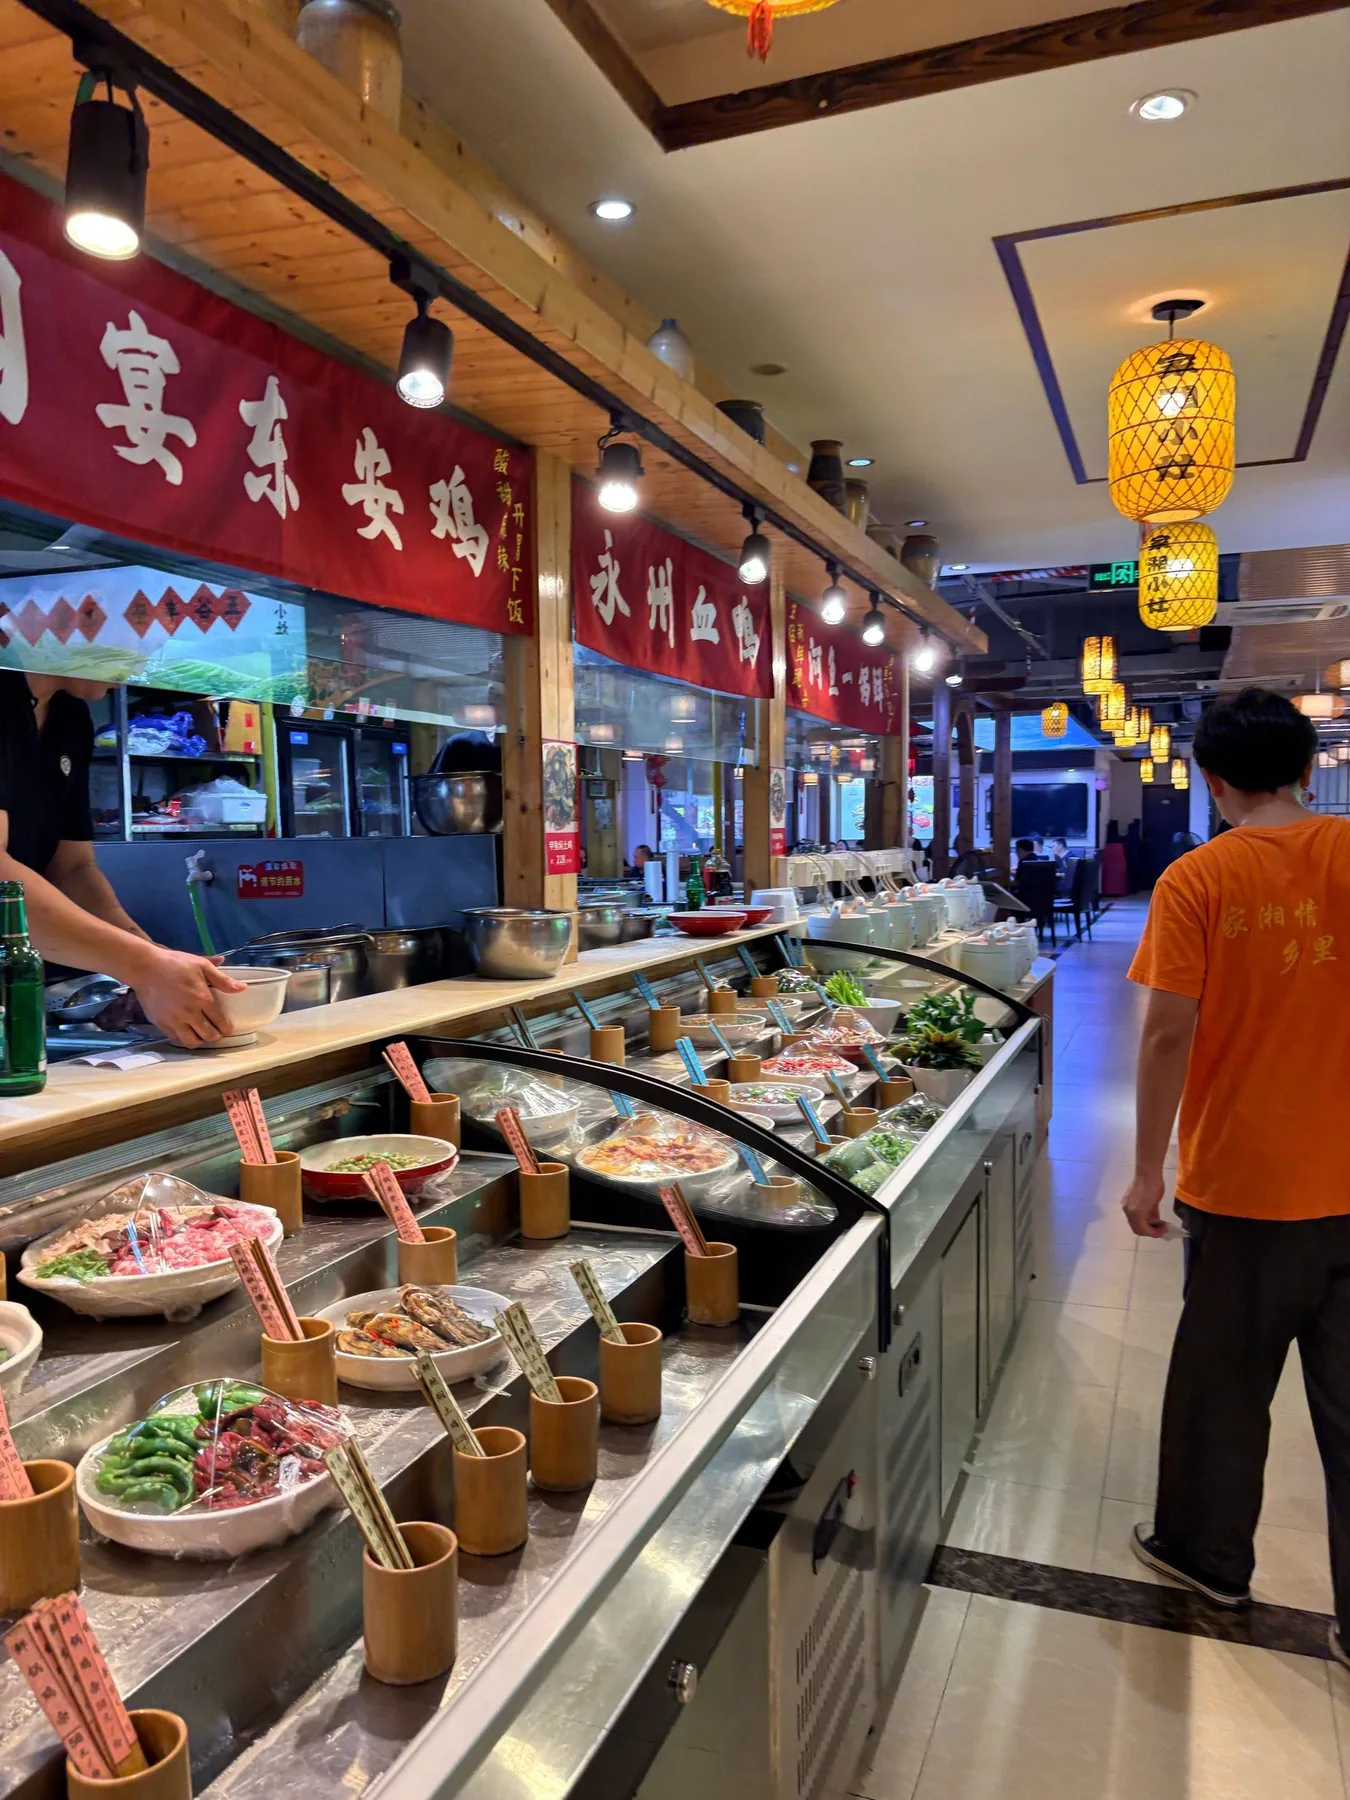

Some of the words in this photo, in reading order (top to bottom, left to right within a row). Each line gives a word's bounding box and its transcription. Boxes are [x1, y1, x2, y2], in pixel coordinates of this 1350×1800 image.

[589, 528, 760, 670] 永州血鸭
[1222, 897, 1318, 939] 家湘情
[1280, 934, 1339, 975] 乡里
